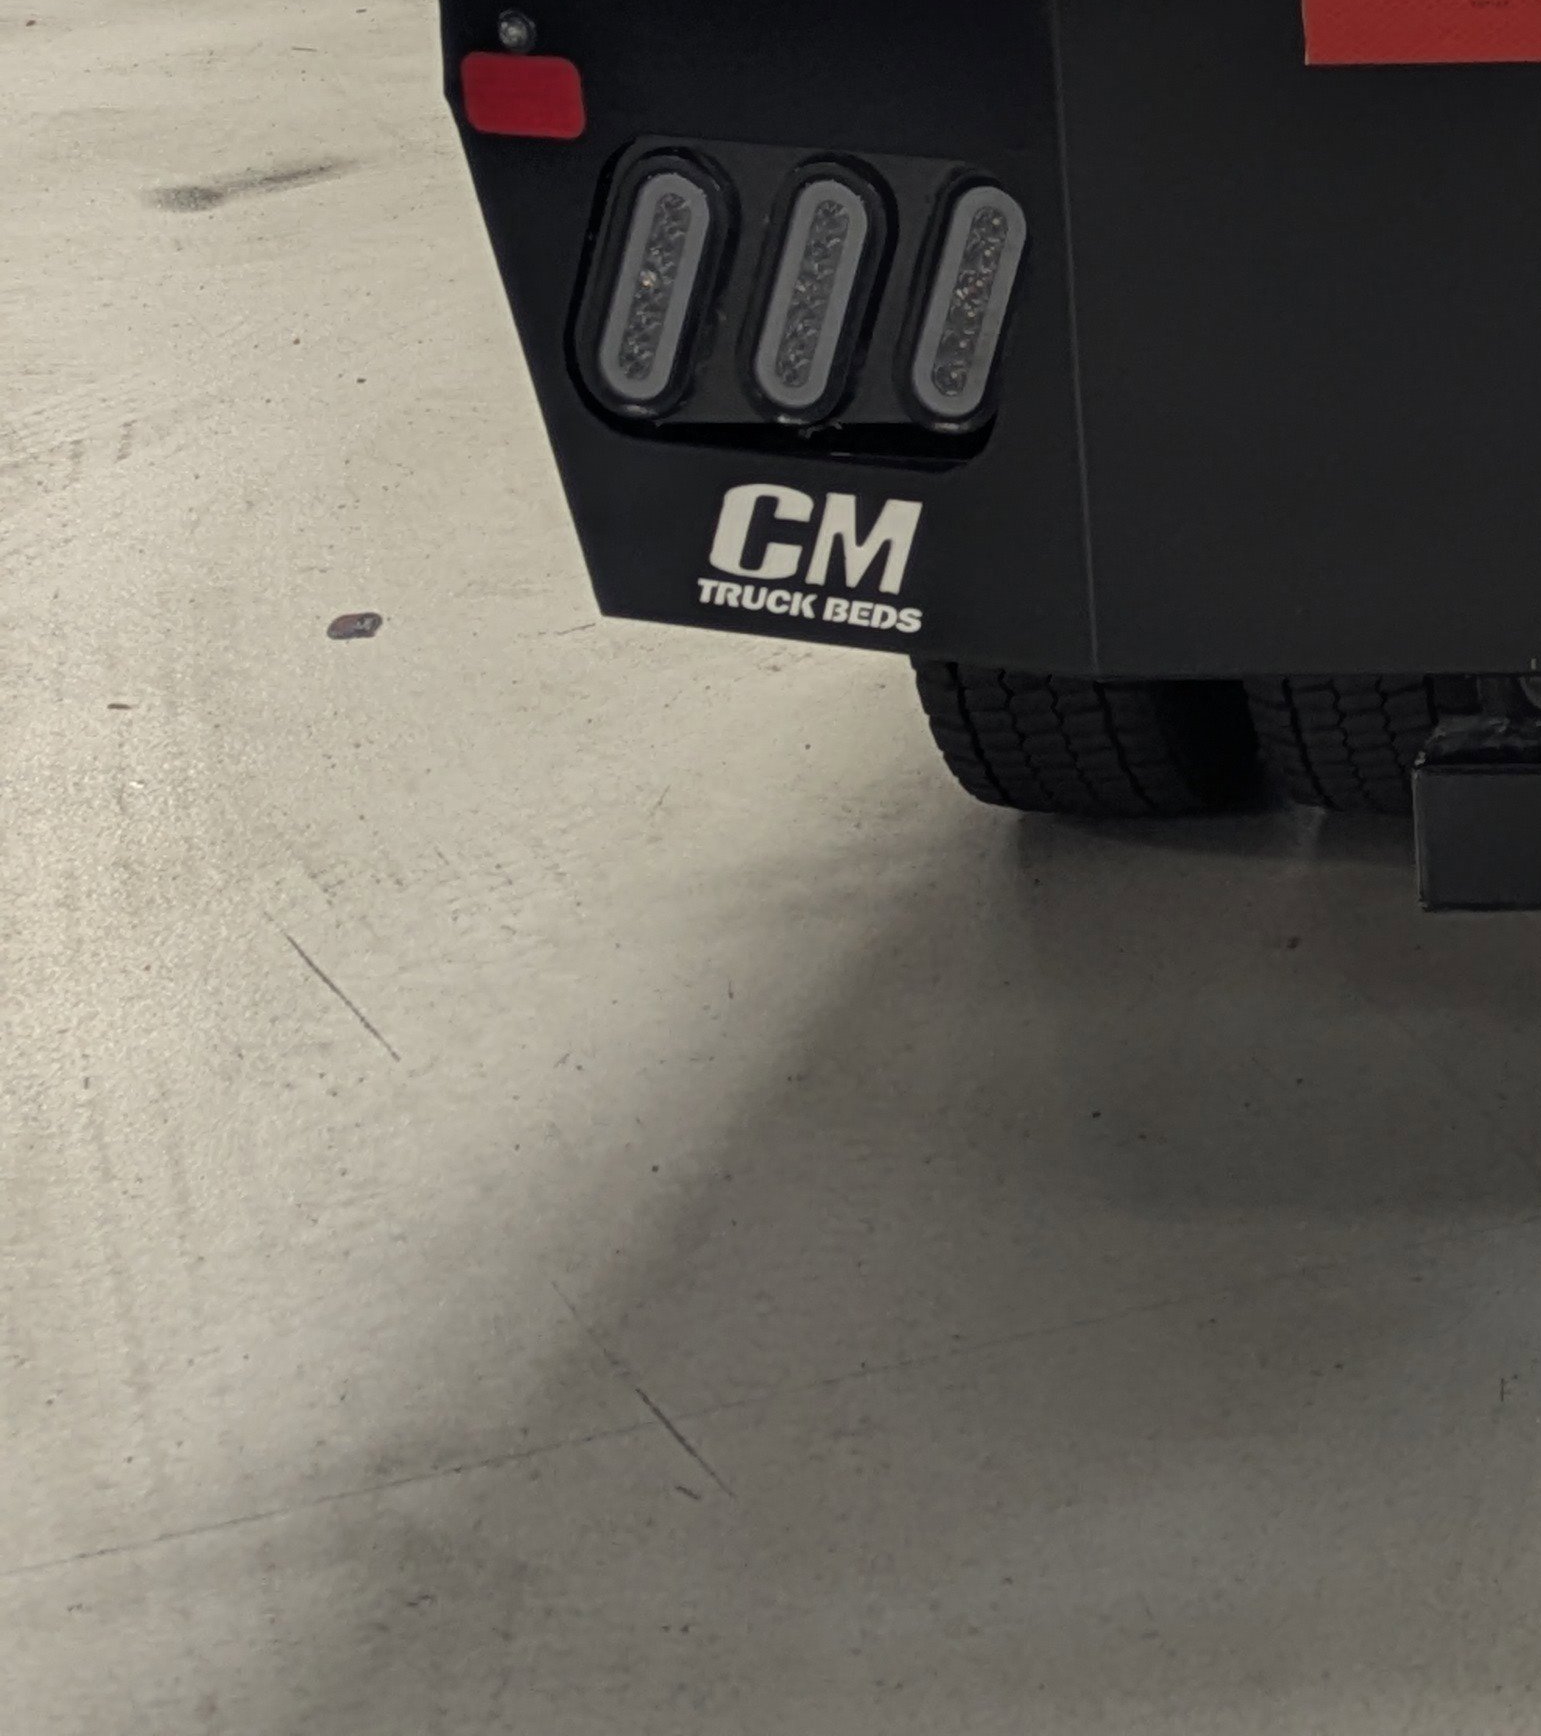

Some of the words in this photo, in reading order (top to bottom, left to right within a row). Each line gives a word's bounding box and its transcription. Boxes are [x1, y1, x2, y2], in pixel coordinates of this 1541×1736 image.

[709, 483, 923, 595] CM
[697, 577, 818, 619] TRUCK
[822, 596, 924, 633] BEDS
